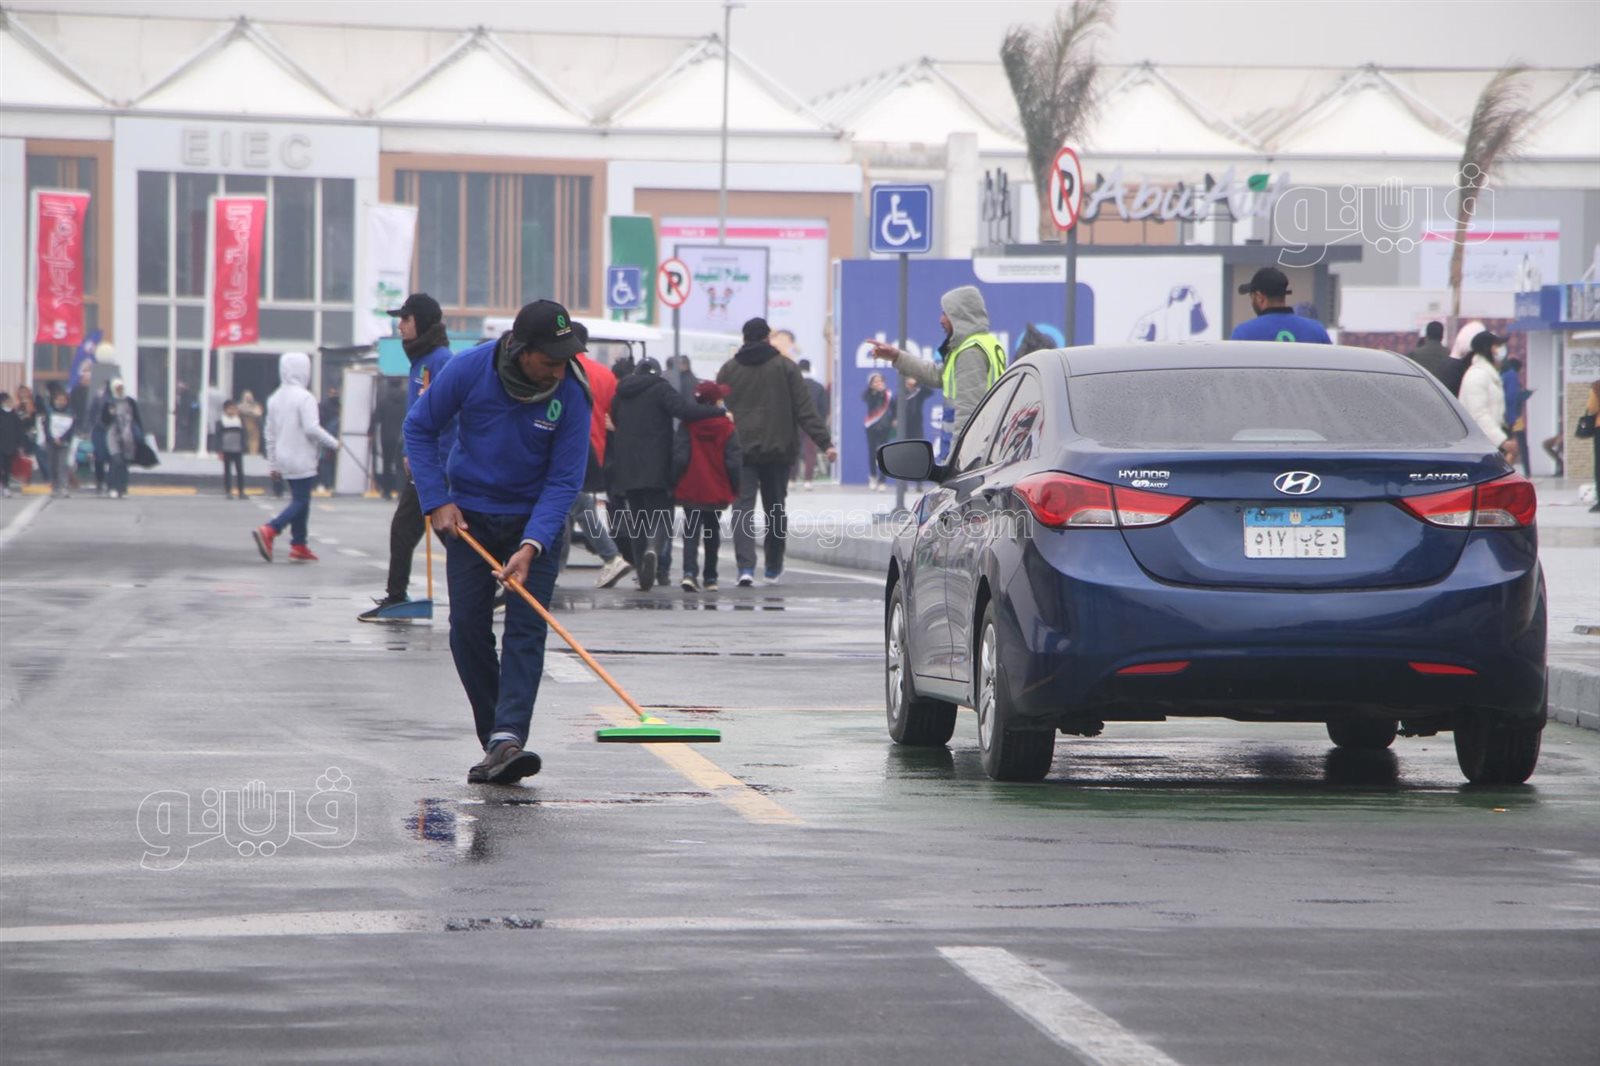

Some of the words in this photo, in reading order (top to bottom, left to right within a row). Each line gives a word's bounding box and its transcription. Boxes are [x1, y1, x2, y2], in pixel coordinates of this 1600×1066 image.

[182, 127, 312, 171] EIEC
[1119, 470, 1170, 480] HYUNDAI
[1409, 473, 1469, 481] ELANTRA
